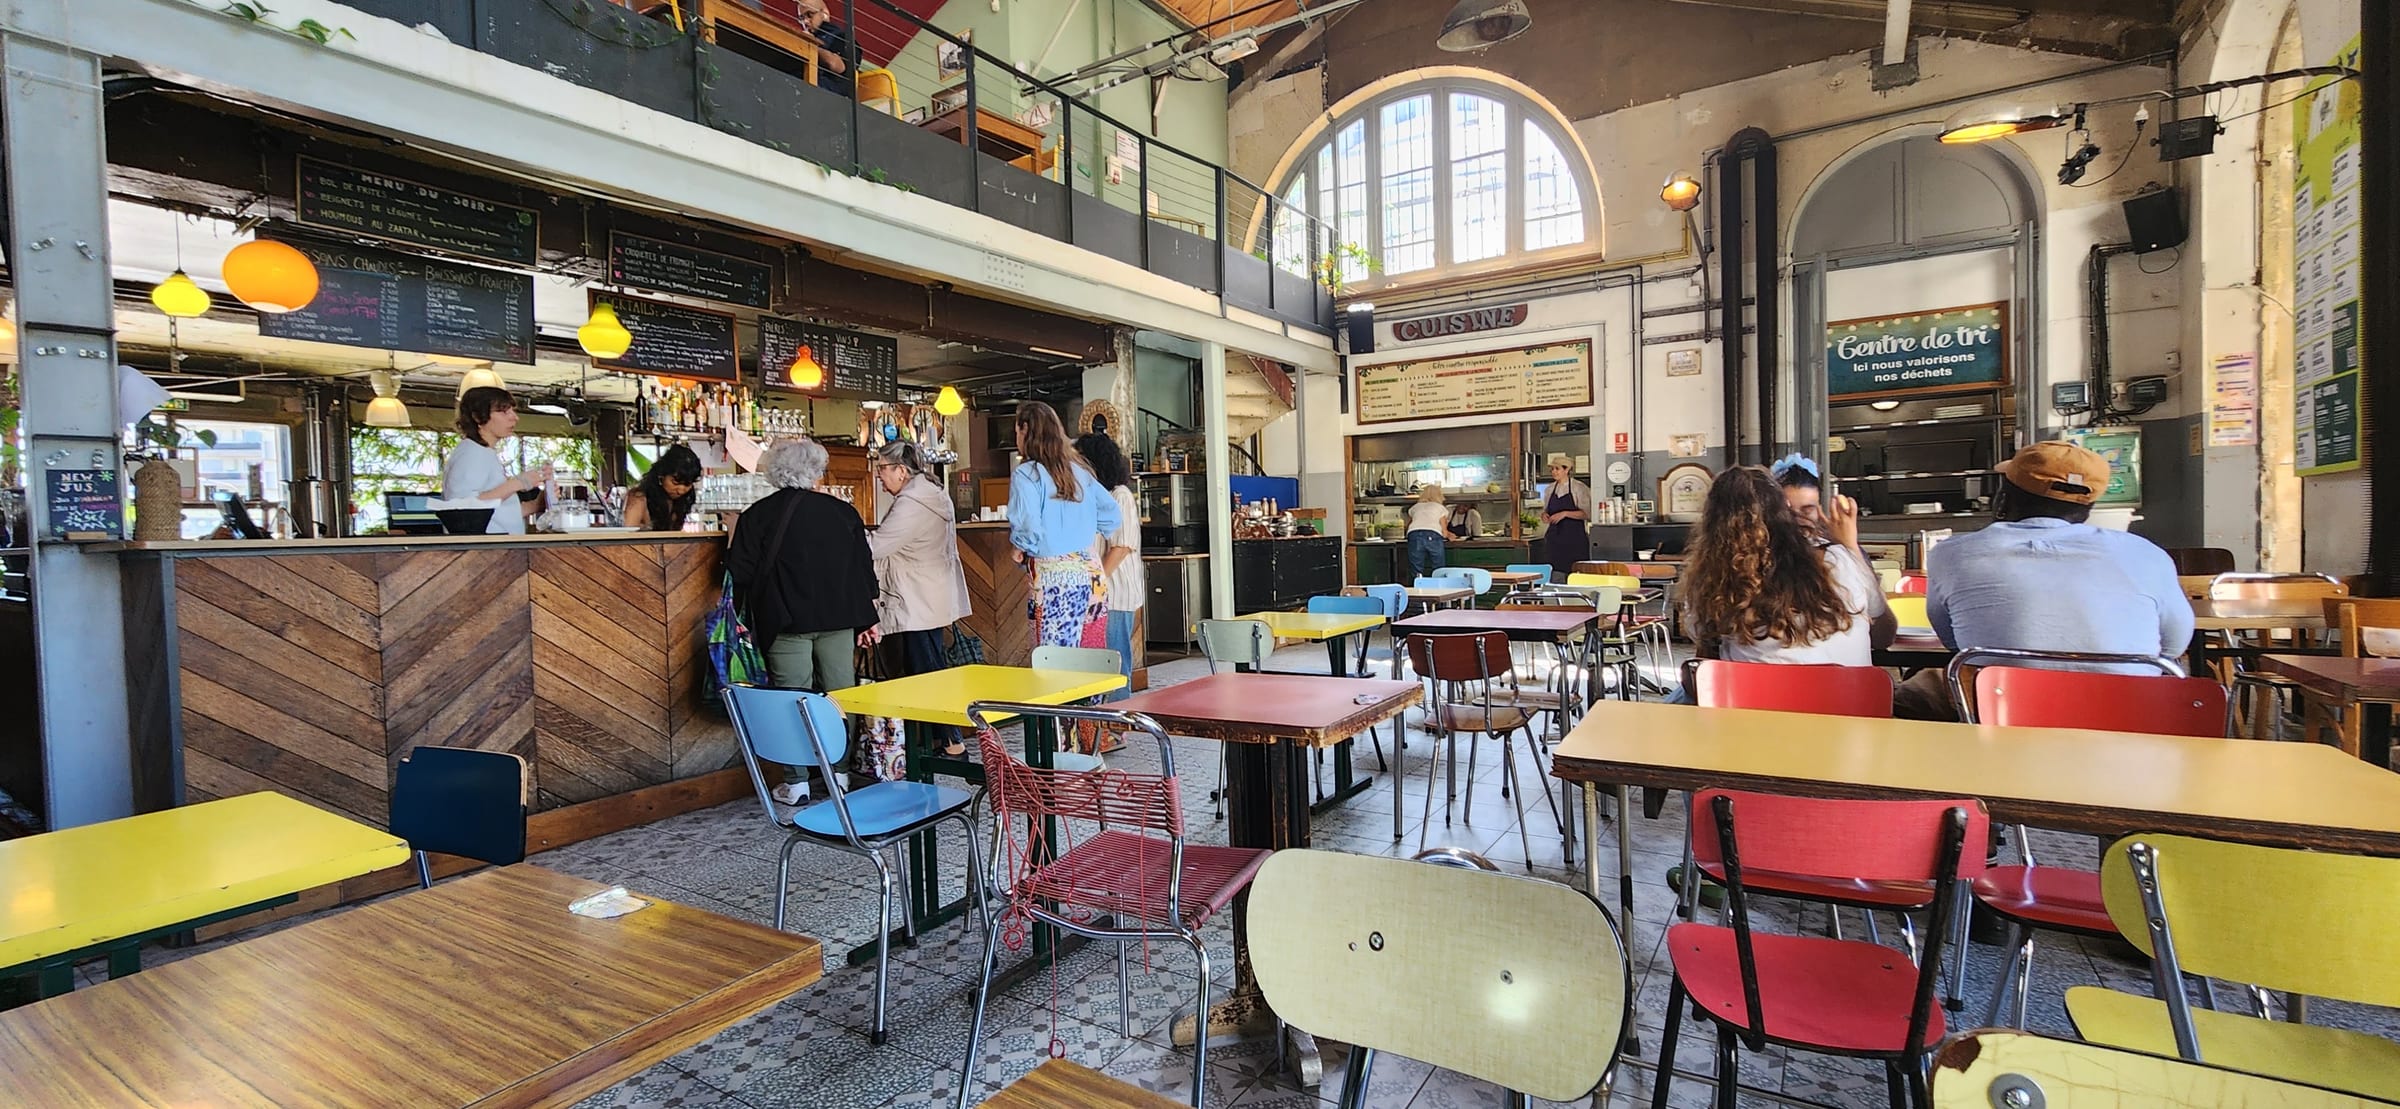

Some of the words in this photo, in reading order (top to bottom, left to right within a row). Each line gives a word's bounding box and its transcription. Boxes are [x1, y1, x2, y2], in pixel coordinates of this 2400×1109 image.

[319, 176, 338, 189] BOL
[342, 182, 354, 191] DE
[356, 185, 387, 199] FRITES
[361, 174, 405, 192] MENU
[418, 187, 439, 199] DU
[319, 193, 365, 209] BEIGNETS
[371, 203, 382, 212] DE
[319, 209, 364, 226] HOUMOUS
[371, 219, 383, 230] AU
[1400, 307, 1516, 339] CUISINE
[1837, 333, 1918, 360] Centre
[1921, 327, 1954, 351] de
[1955, 324, 1991, 346] tri
[1853, 362, 1868, 372] Ici
[1872, 360, 1903, 371] nous
[1906, 352, 1976, 368] valorisons
[1874, 373, 1898, 383] nos
[1901, 367, 1953, 381] déchets
[59, 482, 94, 493] JUS
[61, 473, 93, 482] NEW
